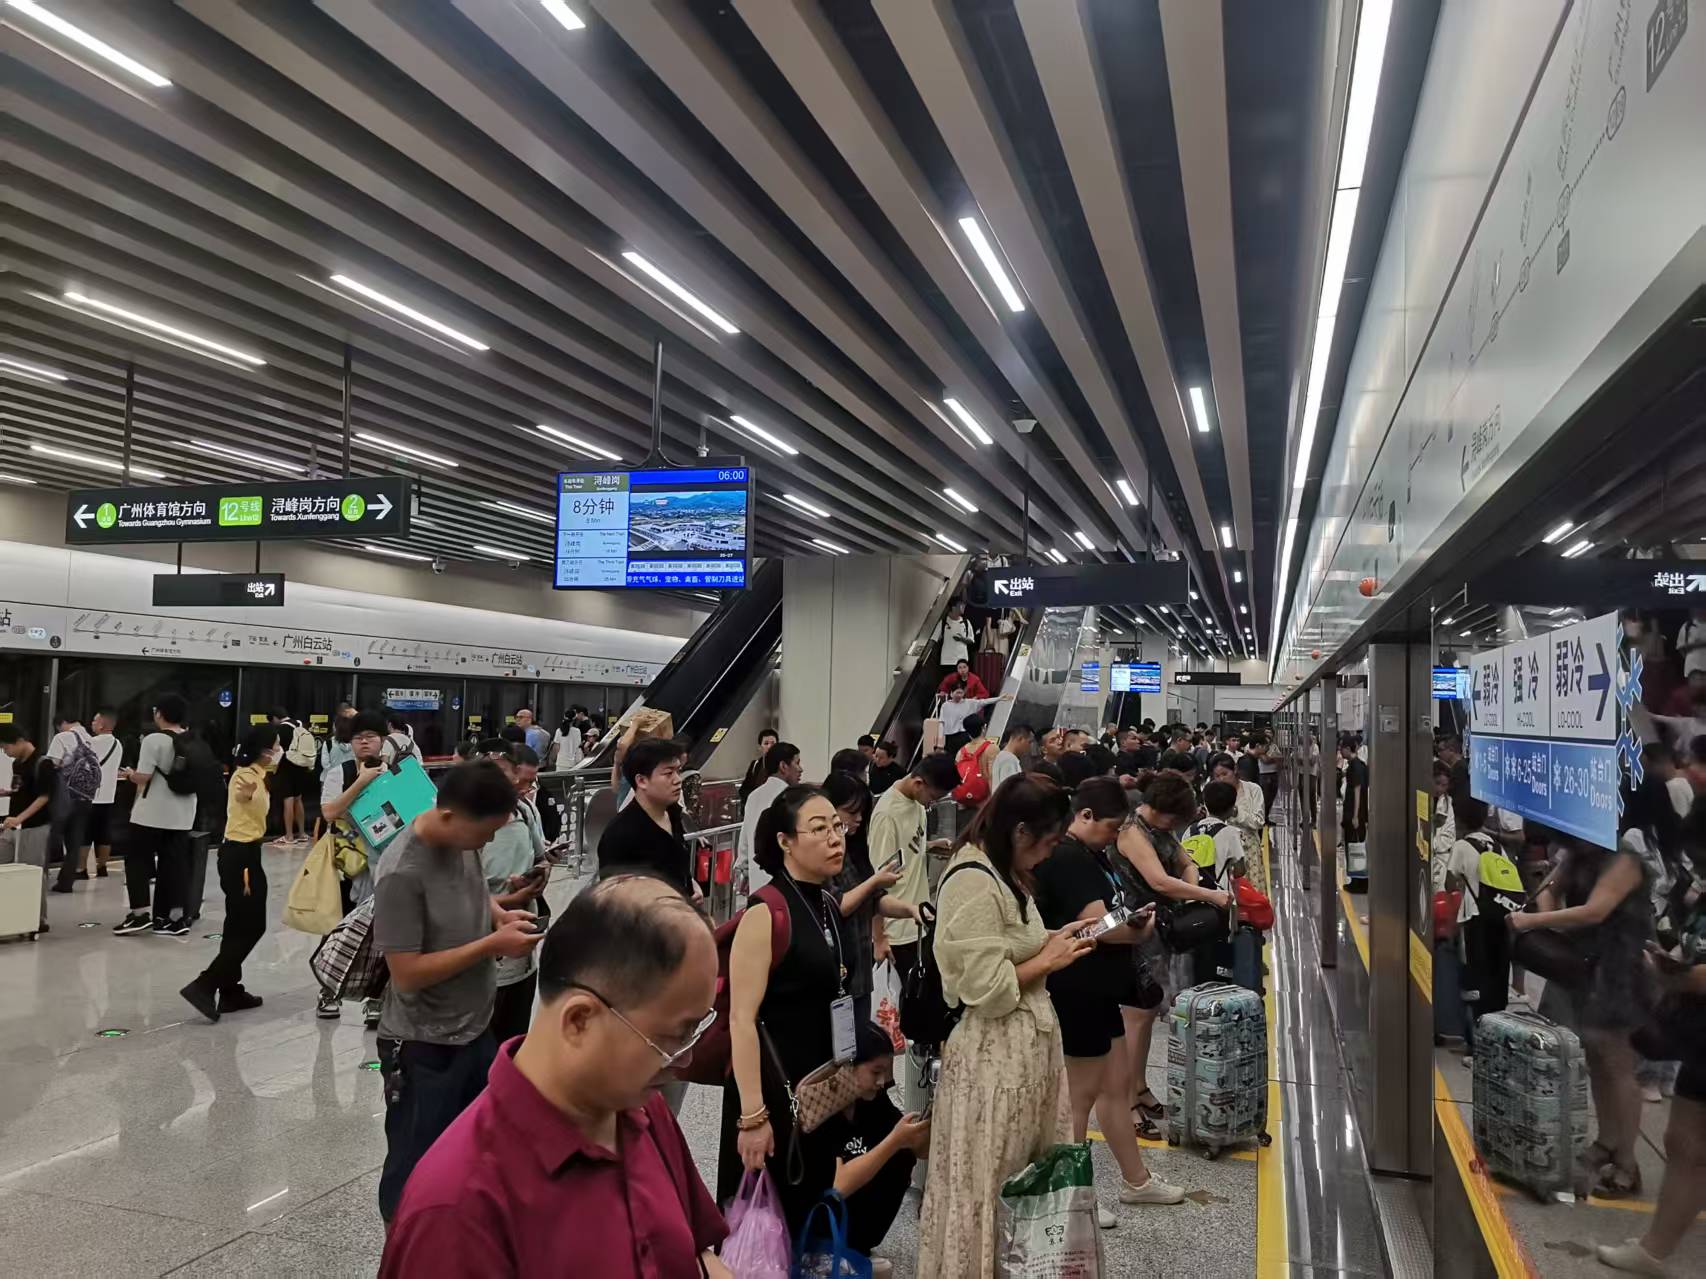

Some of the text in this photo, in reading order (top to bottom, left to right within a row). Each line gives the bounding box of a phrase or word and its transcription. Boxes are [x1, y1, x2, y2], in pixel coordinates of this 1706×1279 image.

[1648, 11, 1665, 72] 12
[719, 471, 744, 480] 06:00
[118, 501, 206, 518] 广州体育馆方向
[221, 502, 239, 520] 12
[271, 497, 340, 513] 浔峰岗方向
[573, 498, 614, 515] 8分钟
[118, 519, 141, 527] Towards
[142, 519, 175, 527] Guangzhou
[270, 513, 296, 521] Towards
[297, 513, 340, 521] Xunfenggang
[247, 582, 264, 593] 出站
[1010, 577, 1034, 590] 出站
[282, 634, 333, 651] 广州白云站
[1556, 636, 1584, 697] 弱冷
[1483, 662, 1499, 706] 弱冷
[1517, 758, 1531, 784] 6-25
[1532, 752, 1547, 774] 站台门
[1590, 755, 1611, 785] 站台门
[1532, 775, 1547, 797] Doors
[1563, 766, 1589, 798] 26-30
[1590, 785, 1612, 812] Doors
